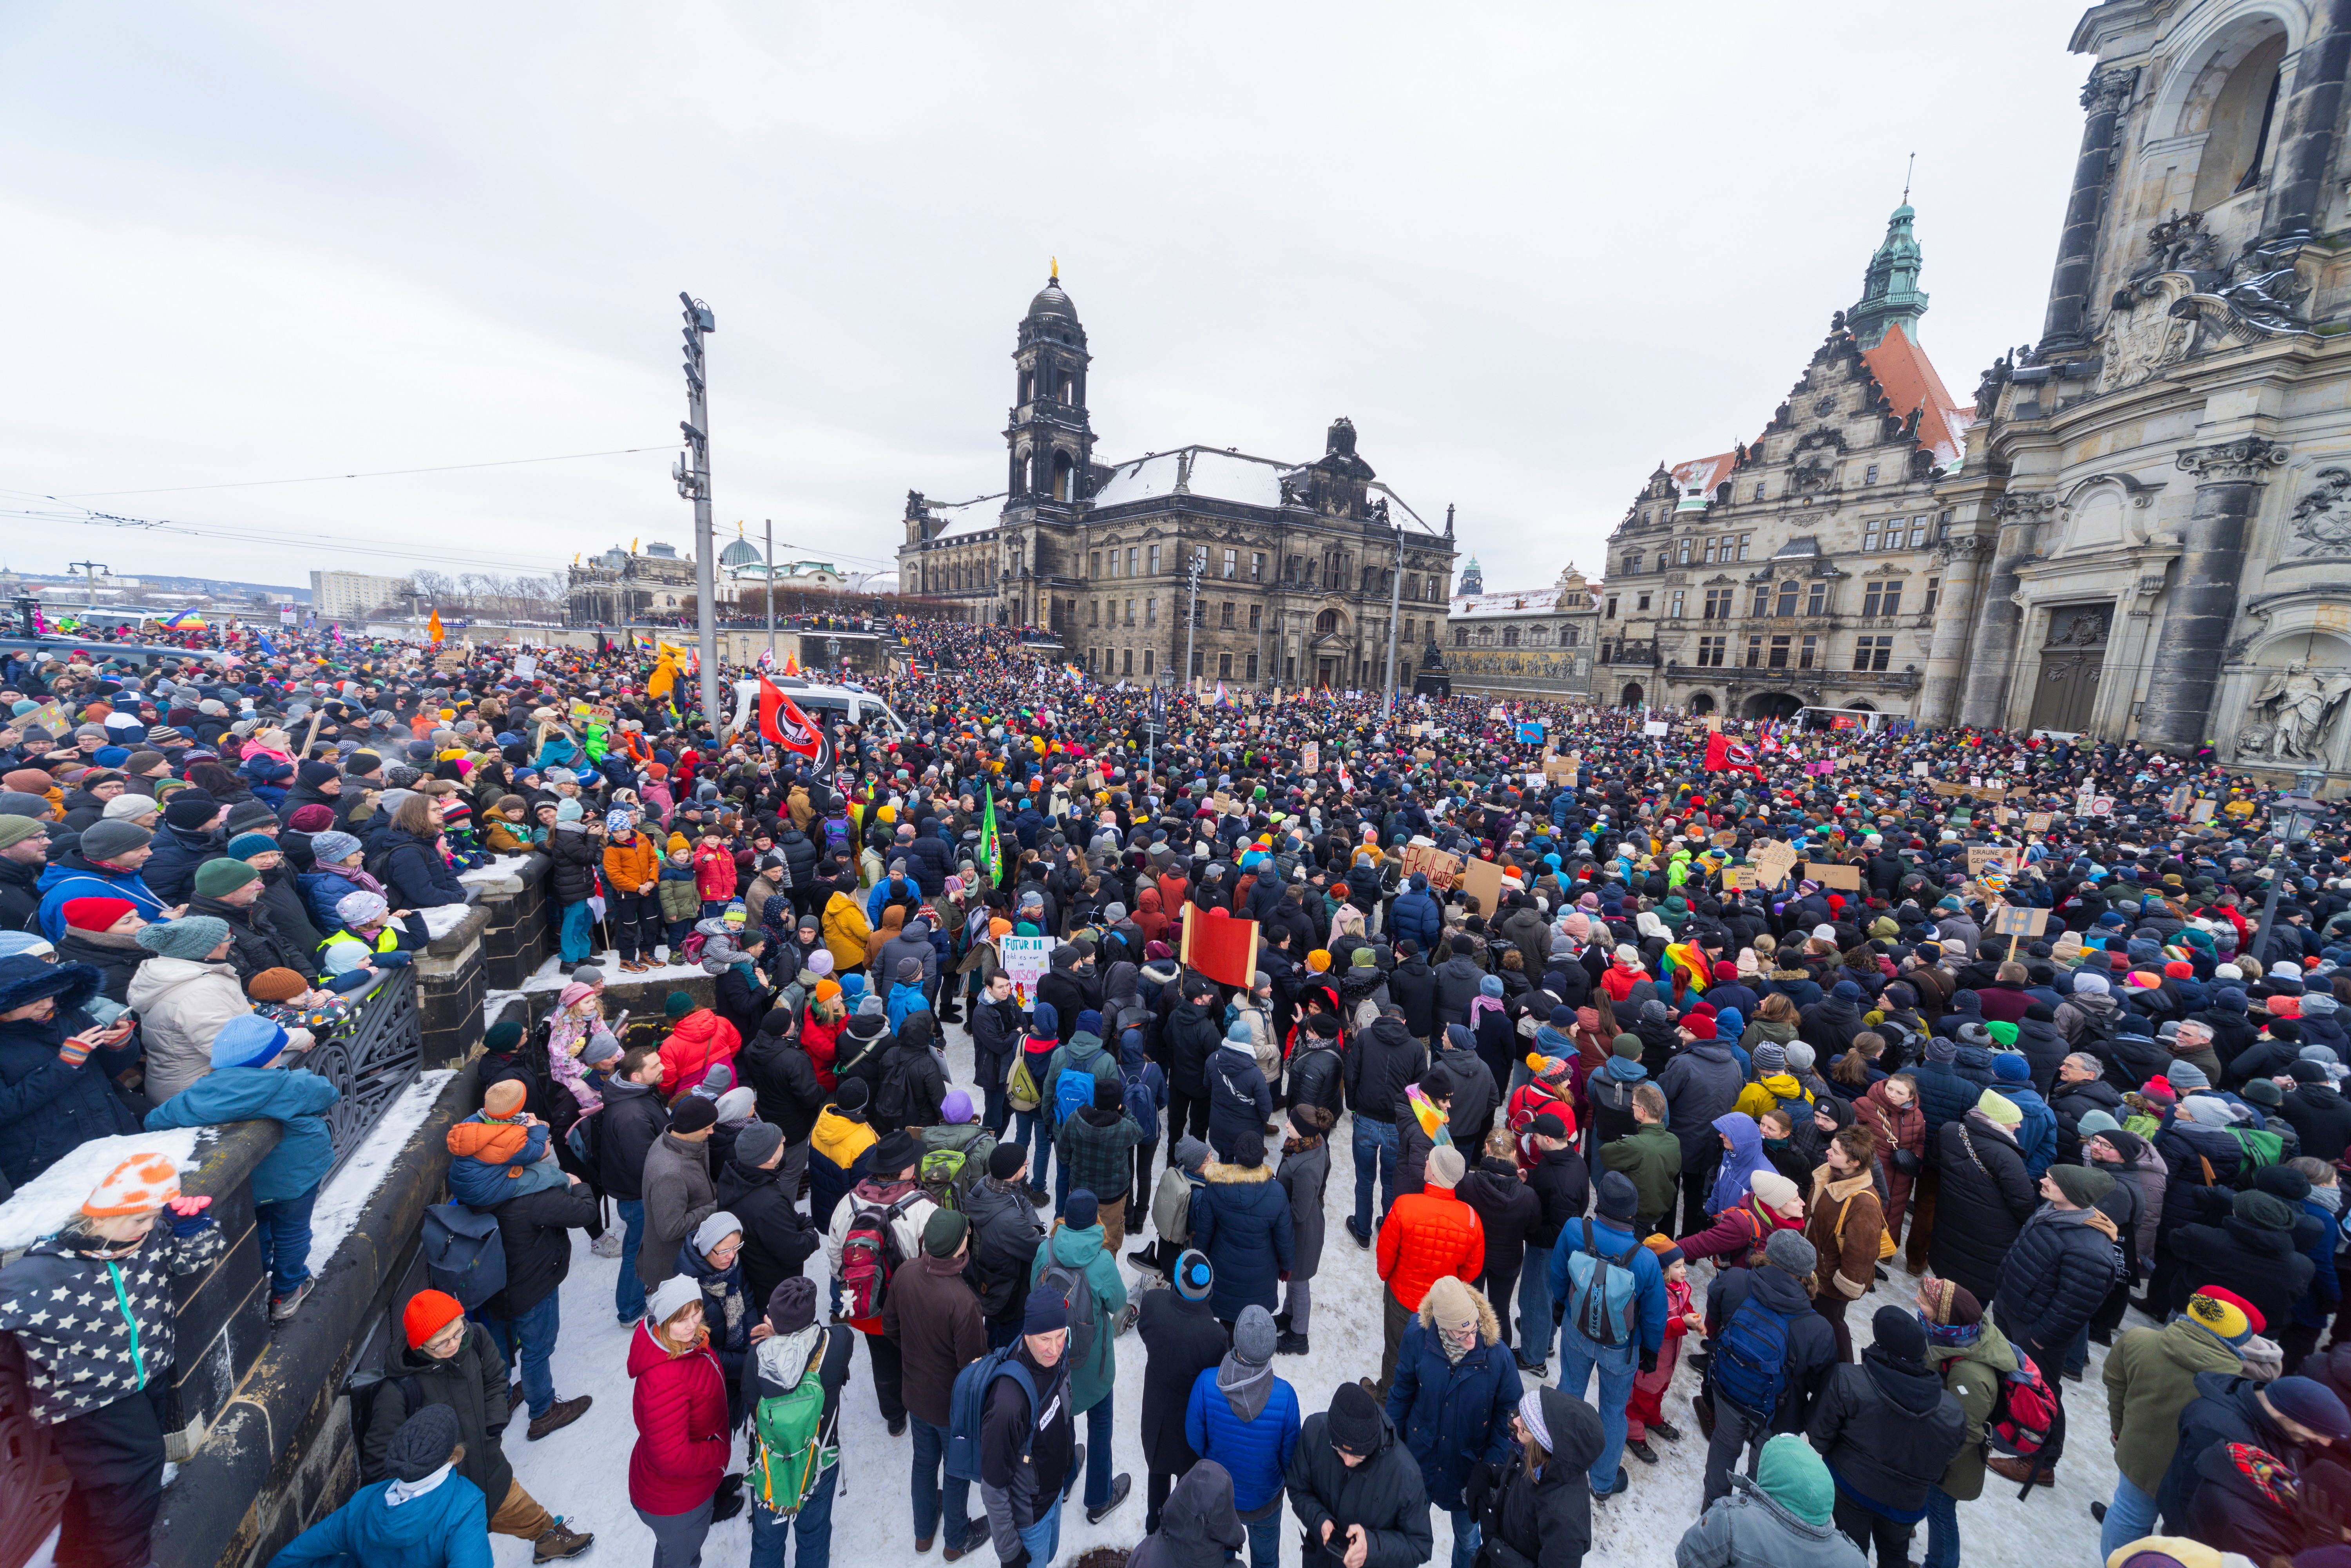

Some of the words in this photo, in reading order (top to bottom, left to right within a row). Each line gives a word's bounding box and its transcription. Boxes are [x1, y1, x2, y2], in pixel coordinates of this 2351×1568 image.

[38, 705, 62, 721] TRASH
[590, 707, 610, 716] AFD
[784, 733, 806, 744] AKTION
[2031, 821, 2047, 829] AFD
[1005, 938, 1029, 951] FUTUR
[1033, 940, 1042, 950] II
[1006, 952, 1016, 963] gibt
[1041, 1399, 1059, 1427] ekelhAFD
